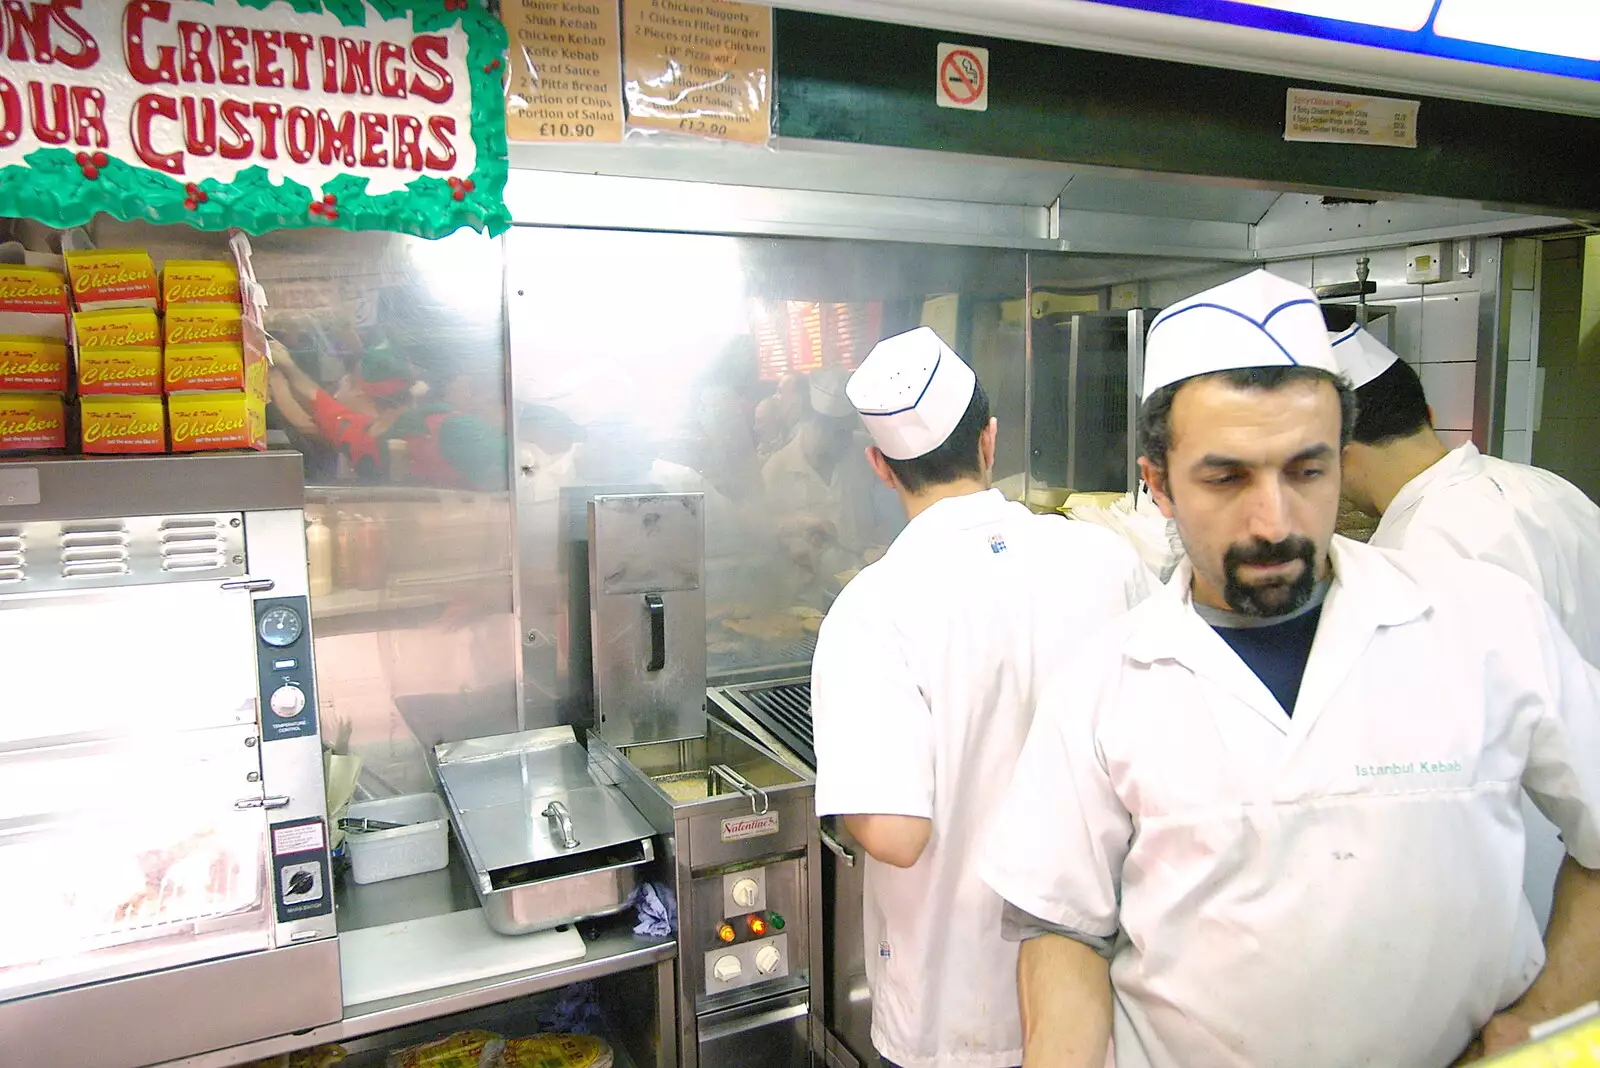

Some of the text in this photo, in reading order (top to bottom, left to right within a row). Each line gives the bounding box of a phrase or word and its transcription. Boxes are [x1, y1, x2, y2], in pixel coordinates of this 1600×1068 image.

[562, 2, 600, 15] Kebab
[661, 0, 704, 14] Chicken
[706, 7, 749, 22] Nuggets
[525, 14, 597, 30] Shish Kebab
[649, 12, 692, 28] Chicken
[723, 25, 760, 38] Burger
[518, 28, 606, 46] Chicken Kebab
[644, 27, 678, 40] Pieces
[681, 33, 692, 43] of
[694, 35, 721, 47] Fried
[724, 41, 766, 54] Chicken
[0, 0, 454, 103] NS GREETINGS
[561, 48, 599, 61] Kebab
[550, 64, 561, 73] of
[564, 65, 600, 77] Sauce
[521, 78, 528, 87] 2
[541, 79, 569, 90] Pitta
[572, 80, 608, 93] Bread
[566, 95, 578, 104] of
[581, 96, 612, 108] Chips
[518, 109, 614, 121] Portion of Salad
[131, 94, 456, 174] CUSTOMERS
[540, 123, 594, 137] £10.90
[75, 267, 149, 293] Chicken
[0, 283, 61, 298] hicken
[166, 281, 236, 303] Chicken
[168, 322, 237, 344] Chicken
[0, 358, 60, 375] hicken
[80, 362, 157, 385] Chicken
[167, 360, 238, 383] Chicken
[0, 416, 59, 435] hicken
[84, 419, 160, 443] Chicken
[174, 416, 244, 442] Chicken
[1355, 760, 1462, 777] Istanbul Kebab
